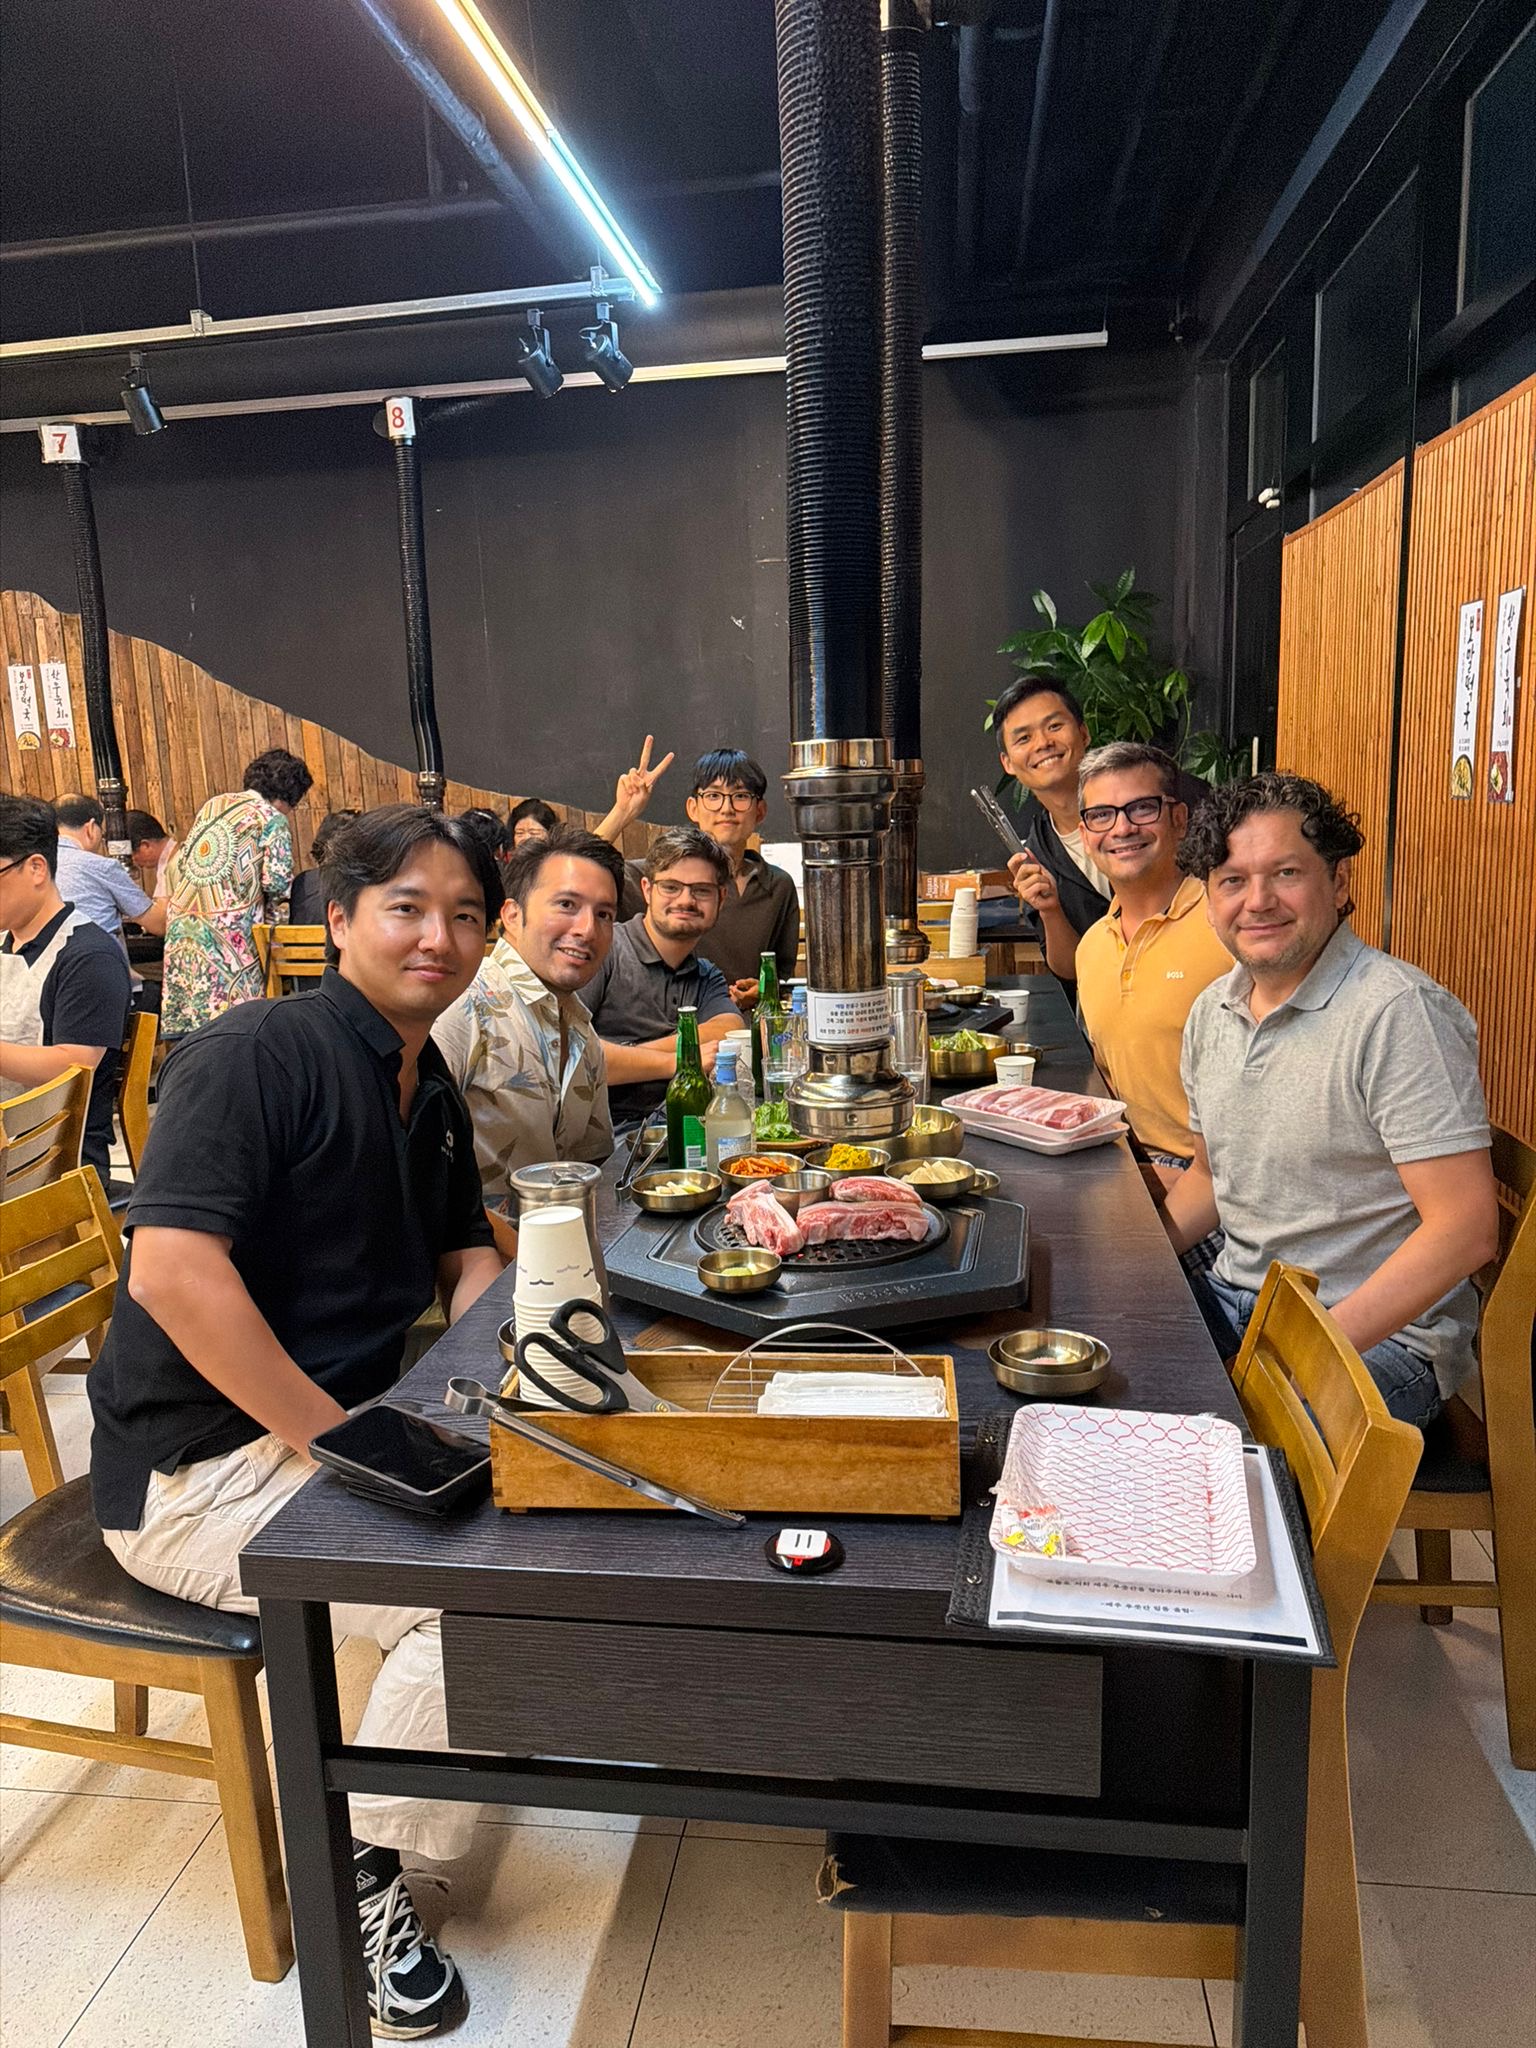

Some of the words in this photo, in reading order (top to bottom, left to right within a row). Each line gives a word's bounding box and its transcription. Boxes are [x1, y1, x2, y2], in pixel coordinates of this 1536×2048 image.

[391, 406, 405, 428] 8
[52, 433, 67, 454] 7
[794, 1533, 812, 1549] 11
